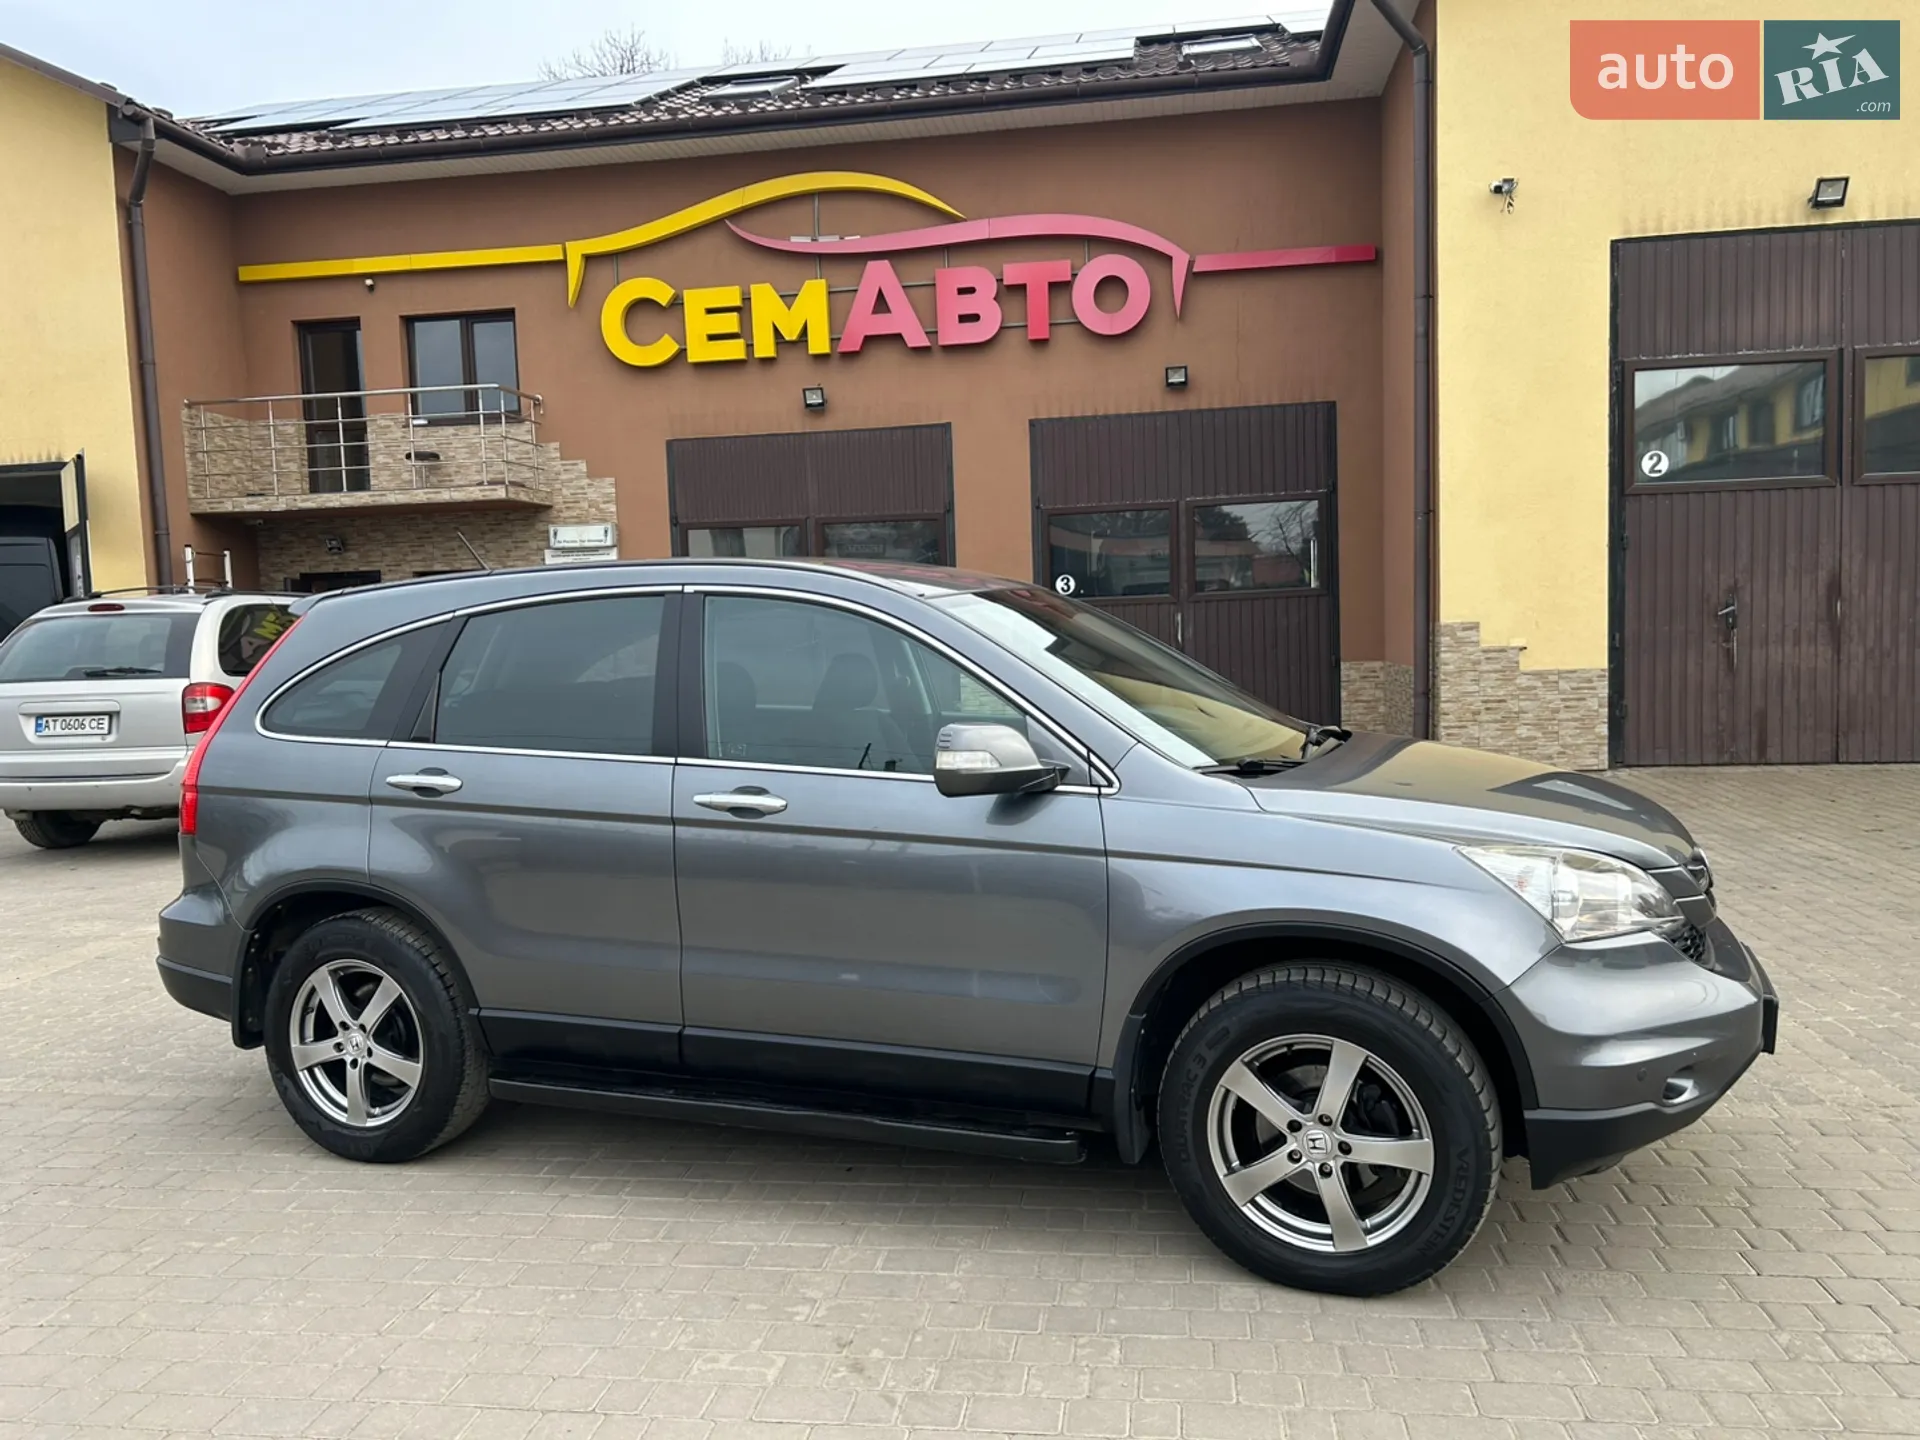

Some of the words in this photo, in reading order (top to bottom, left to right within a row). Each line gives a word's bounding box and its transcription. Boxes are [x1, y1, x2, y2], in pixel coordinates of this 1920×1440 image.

[1648, 452, 1662, 475] 2
[1060, 576, 1071, 593] 3
[44, 718, 59, 731] AT
[60, 718, 87, 731] 0606
[88, 717, 105, 730] CE
[1416, 1146, 1470, 1257] VREDESTEIN
